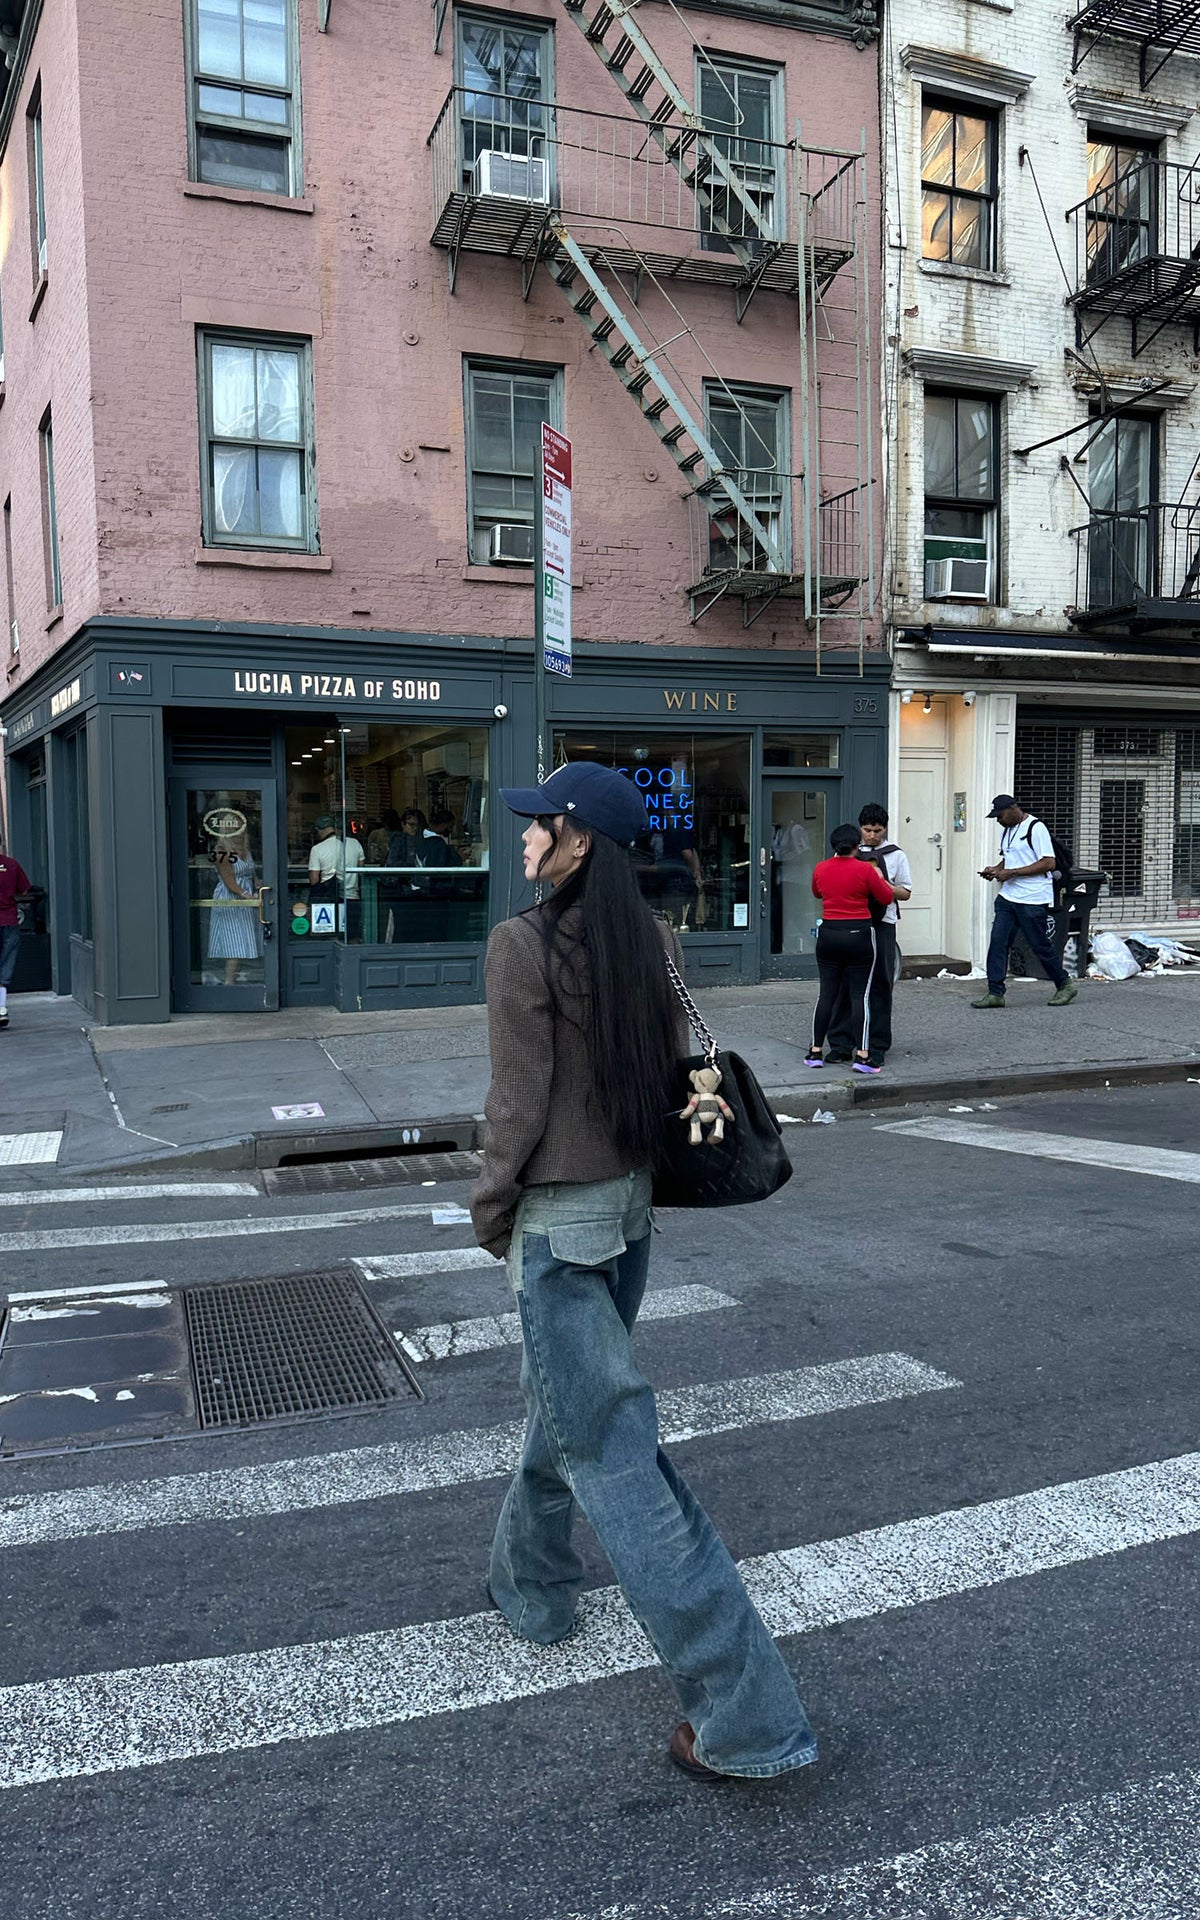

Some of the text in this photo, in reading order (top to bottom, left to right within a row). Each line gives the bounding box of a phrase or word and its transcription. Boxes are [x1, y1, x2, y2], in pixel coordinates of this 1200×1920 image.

[545, 476, 551, 496] 3
[546, 576, 551, 596] 5
[234, 671, 441, 700] LUCIA PIZZA OF SOHO
[663, 690, 737, 711] WINE
[854, 697, 878, 712] 375
[1120, 741, 1135, 750] 373
[617, 767, 692, 787] OOL
[645, 793, 694, 809] NE&
[649, 815, 694, 830] RITS
[208, 850, 239, 864] 375
[315, 907, 332, 924] A
